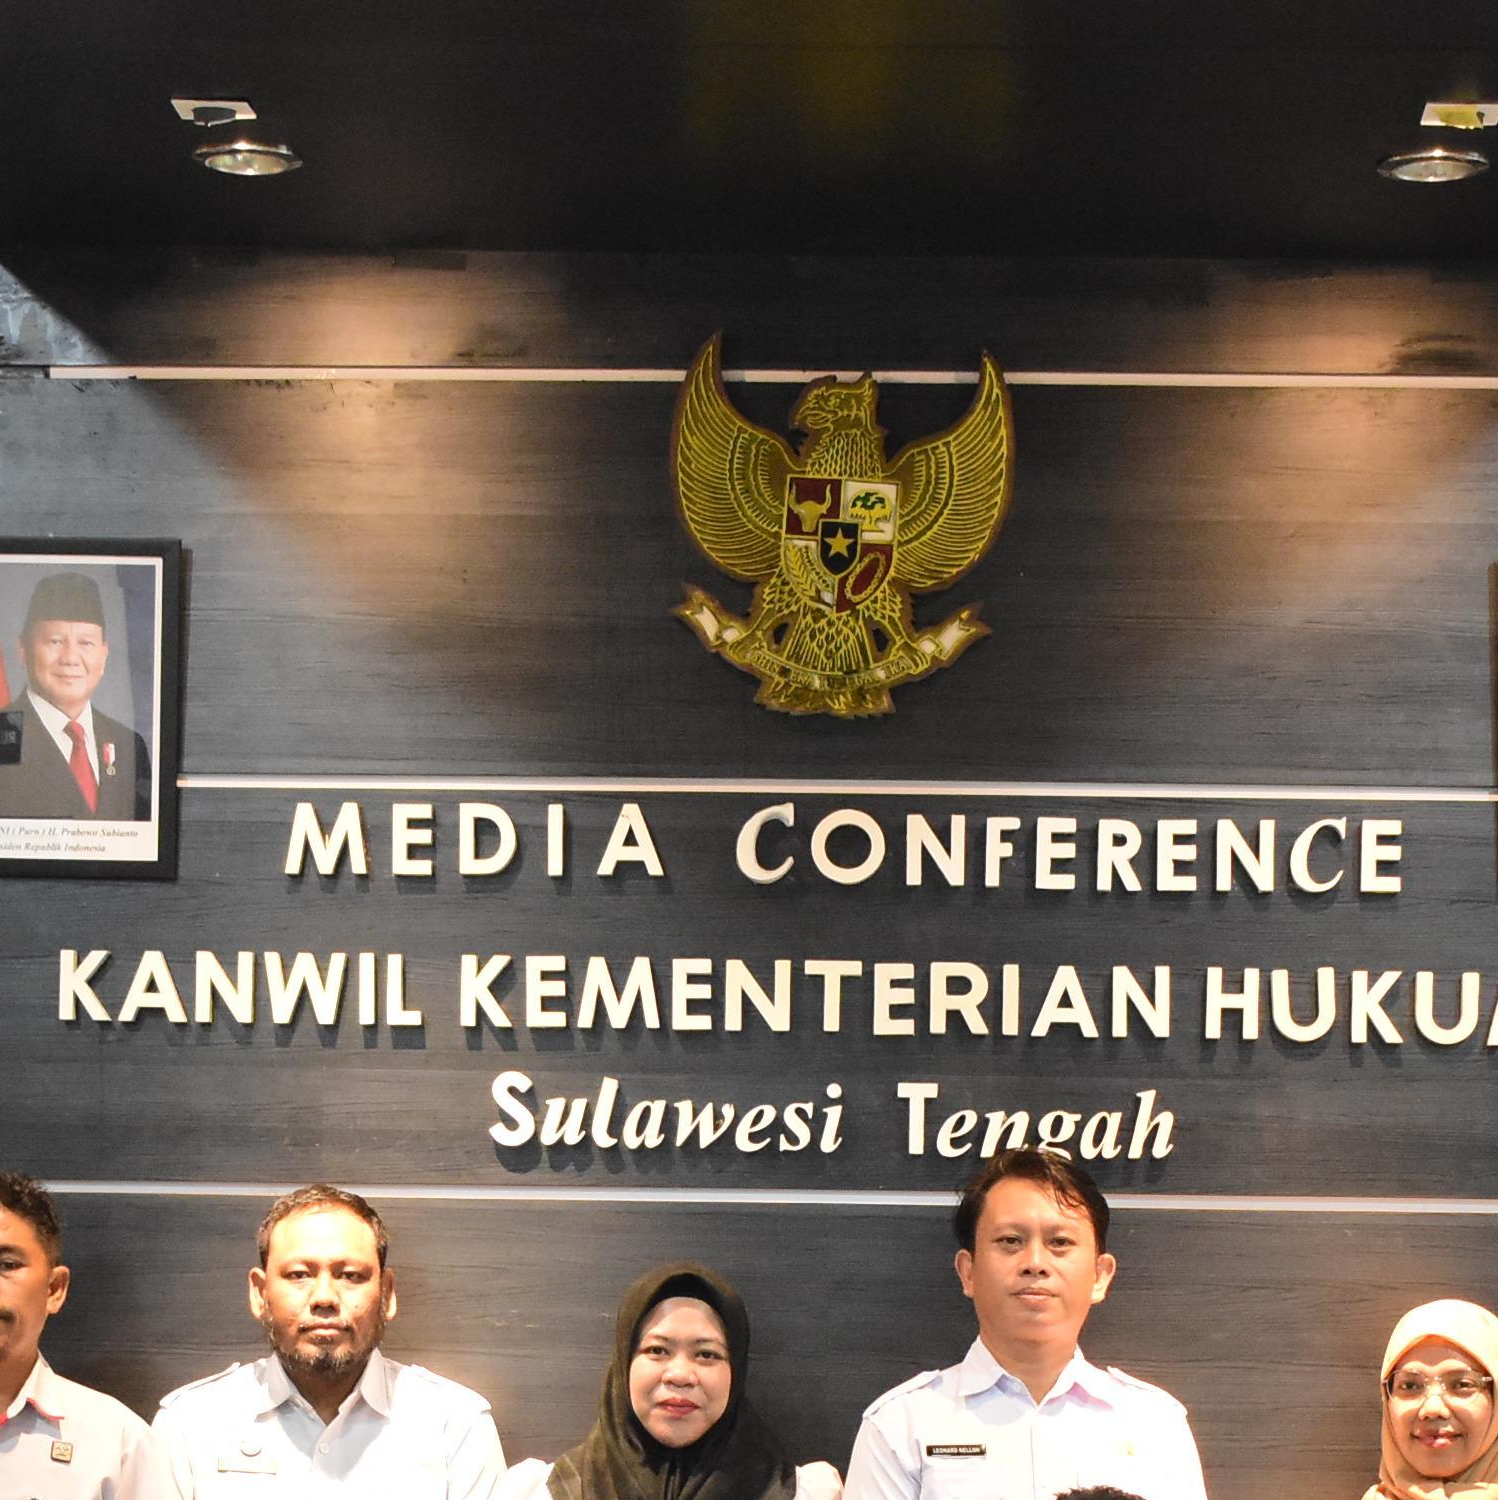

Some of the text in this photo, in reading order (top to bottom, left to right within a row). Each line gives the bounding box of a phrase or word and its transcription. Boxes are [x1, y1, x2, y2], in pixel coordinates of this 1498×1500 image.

[24, 842, 62, 853] Republik
[64, 843, 106, 853] Indonesia
[61, 827, 98, 837] Prabowo
[100, 828, 139, 838] Subianto
[285, 801, 1403, 893] MEDIA CONFERENCE
[58, 949, 423, 1026] KANWIL
[459, 954, 1170, 1039] KEMENTERIAN
[488, 1070, 1175, 1161] Sulawesi Tengah
